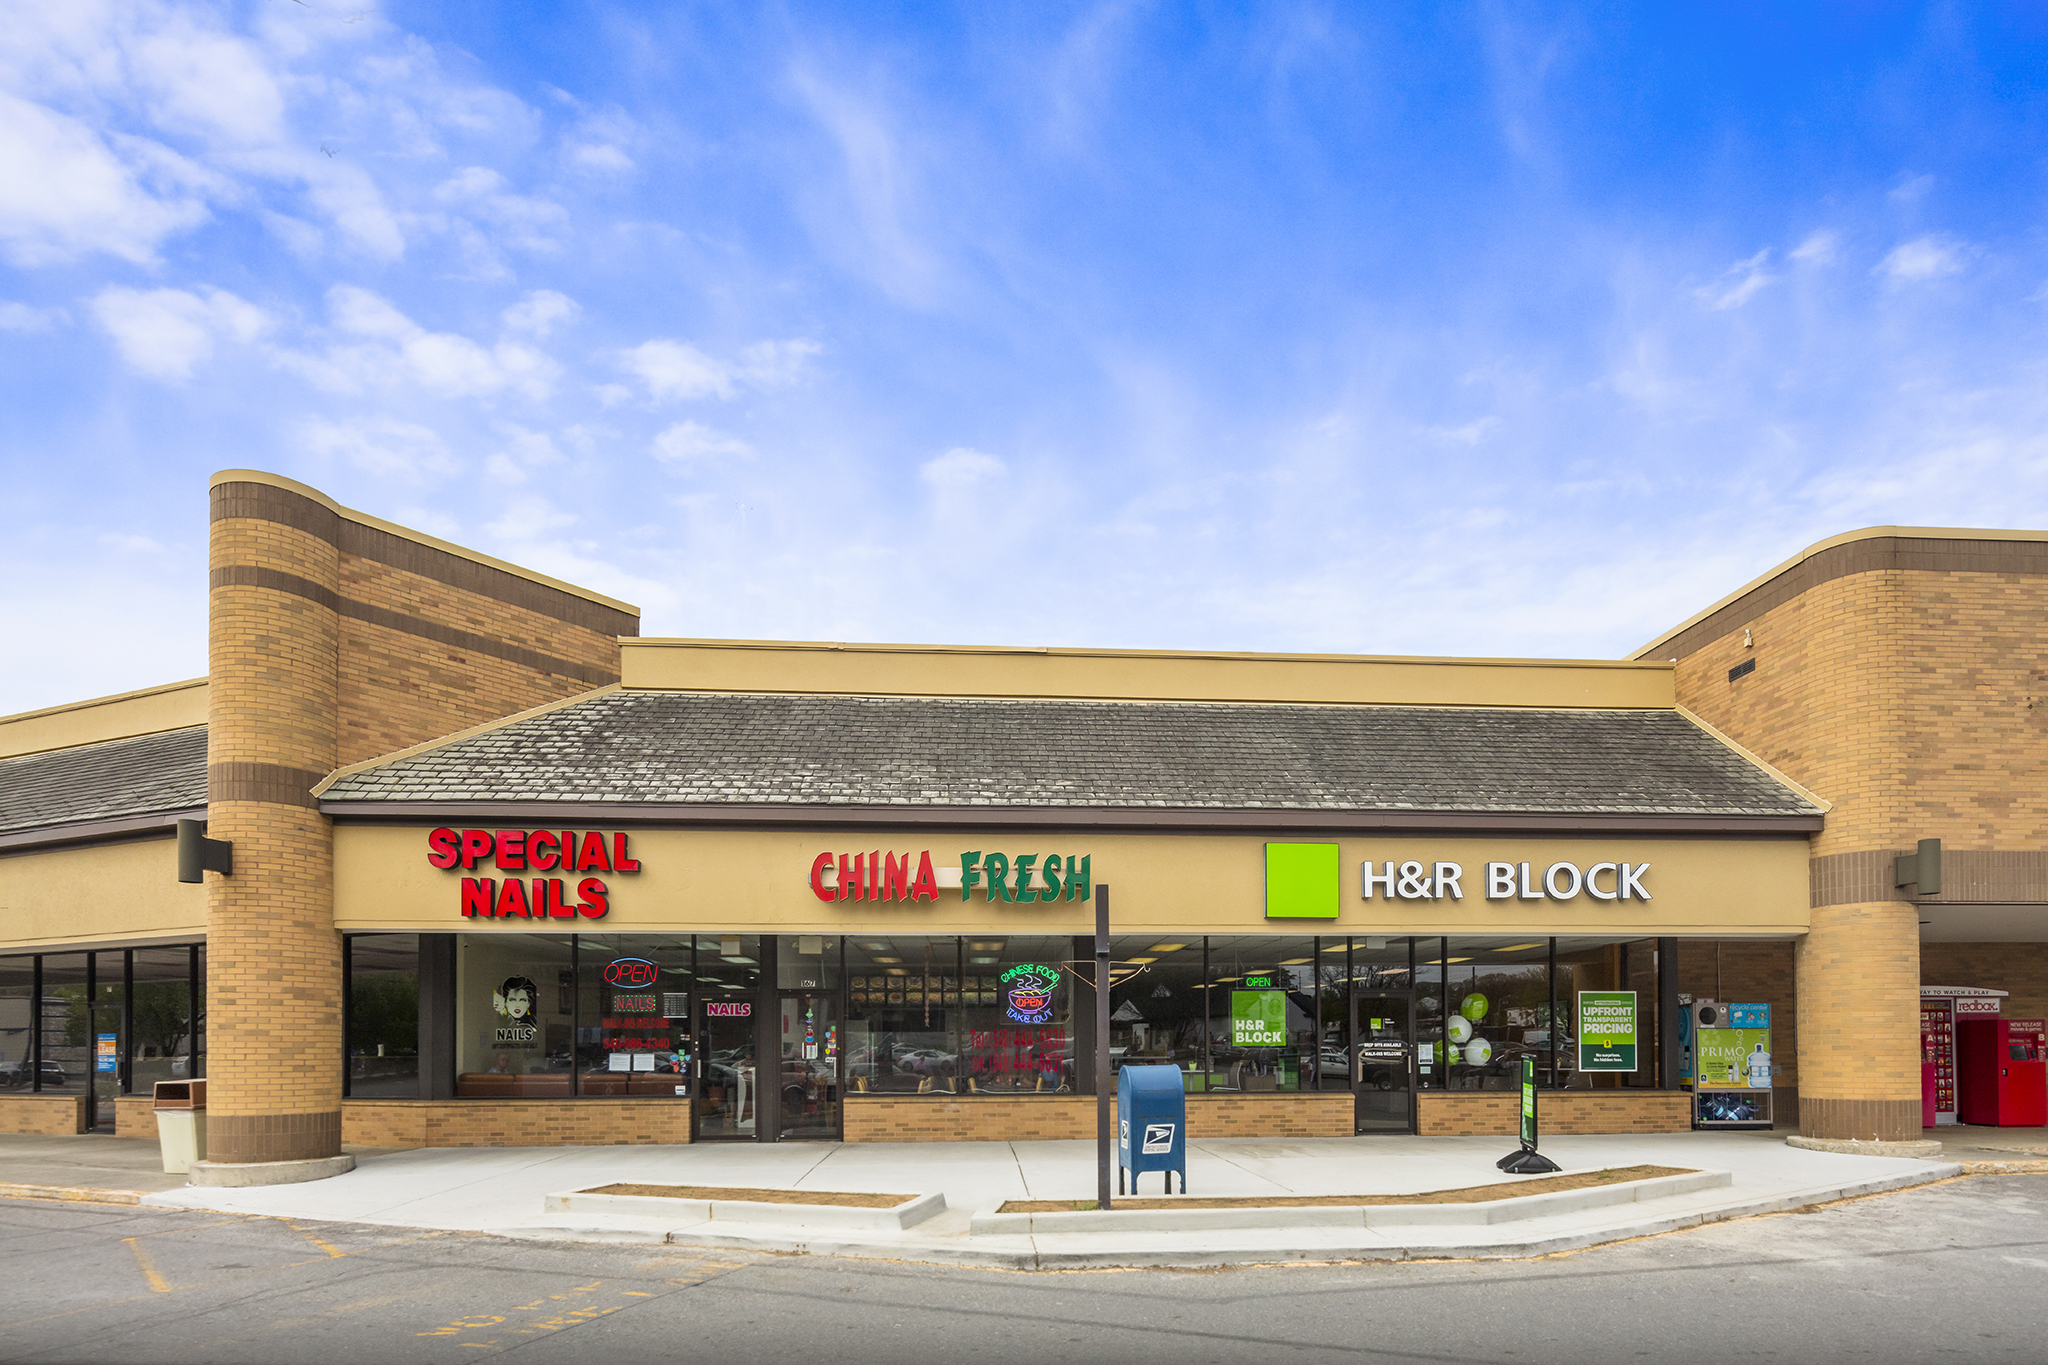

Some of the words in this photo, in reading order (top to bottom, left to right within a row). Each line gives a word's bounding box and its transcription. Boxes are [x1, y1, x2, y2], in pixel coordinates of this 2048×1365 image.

[428, 827, 641, 872] SPECIAL
[811, 850, 940, 903] CHINA
[960, 851, 1091, 904] FRESH
[1361, 861, 1464, 900] H&R
[1485, 862, 1653, 900] BLOCK
[461, 877, 609, 919] NAILS
[603, 964, 659, 982] OPEN
[1000, 963, 1034, 983] CHINESE
[1036, 965, 1060, 983] FOOD
[1246, 977, 1271, 987] OPEN
[616, 998, 654, 1009] NAILS
[1015, 997, 1043, 1007] OPEN
[707, 1003, 751, 1017] NAILS
[1006, 1007, 1030, 1023] TAKE
[1032, 1008, 1053, 1023] OUT
[1583, 1007, 1633, 1016] UPFRONT
[1236, 1020, 1265, 1030] H&R
[1583, 1024, 1633, 1034] PRICING
[496, 1028, 534, 1041] NAILS
[1236, 1032, 1282, 1043] BLOCK
[1926, 1034, 1934, 1042] A
[2038, 1033, 2045, 1041] B
[1701, 1047, 1745, 1057] PRIMO
[971, 1056, 985, 1073] OR
